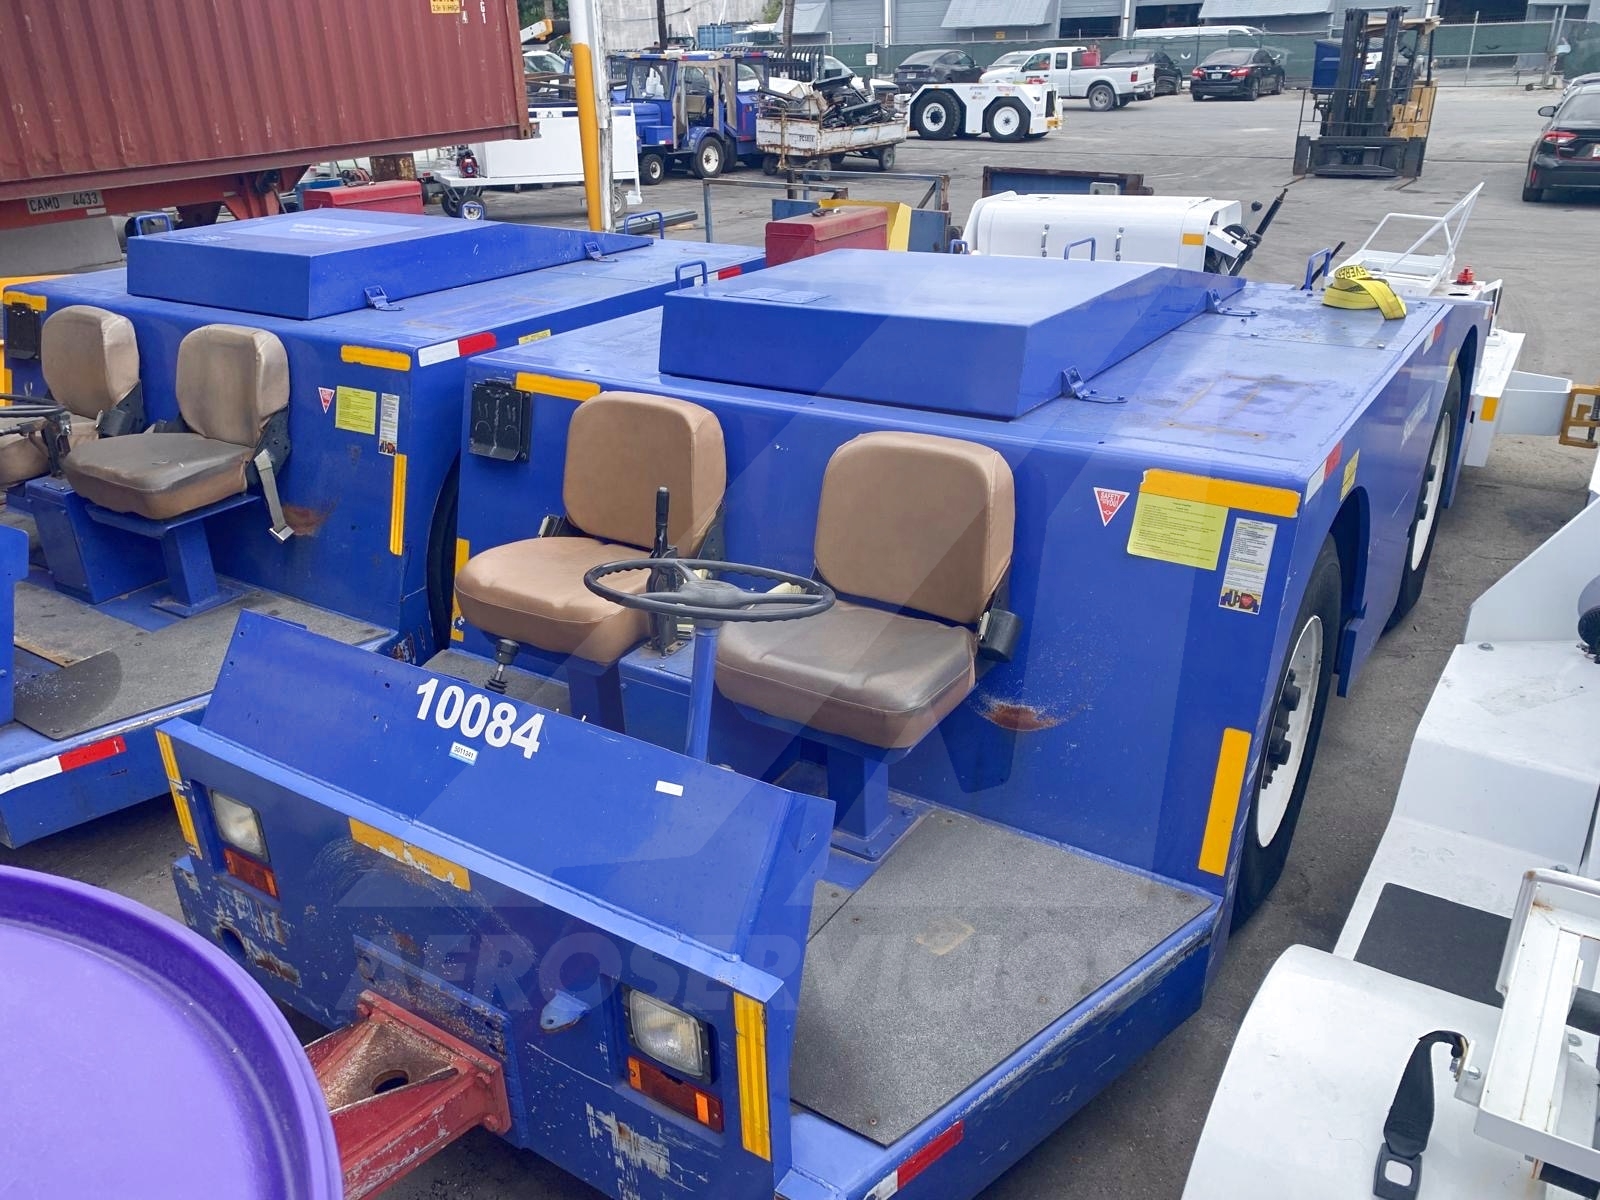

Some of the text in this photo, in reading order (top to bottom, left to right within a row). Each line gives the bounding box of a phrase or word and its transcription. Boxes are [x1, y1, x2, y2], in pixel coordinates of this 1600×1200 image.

[72, 191, 99, 206] 4433
[1100, 492, 1120, 502] SAFETY
[416, 677, 545, 760] 10084
